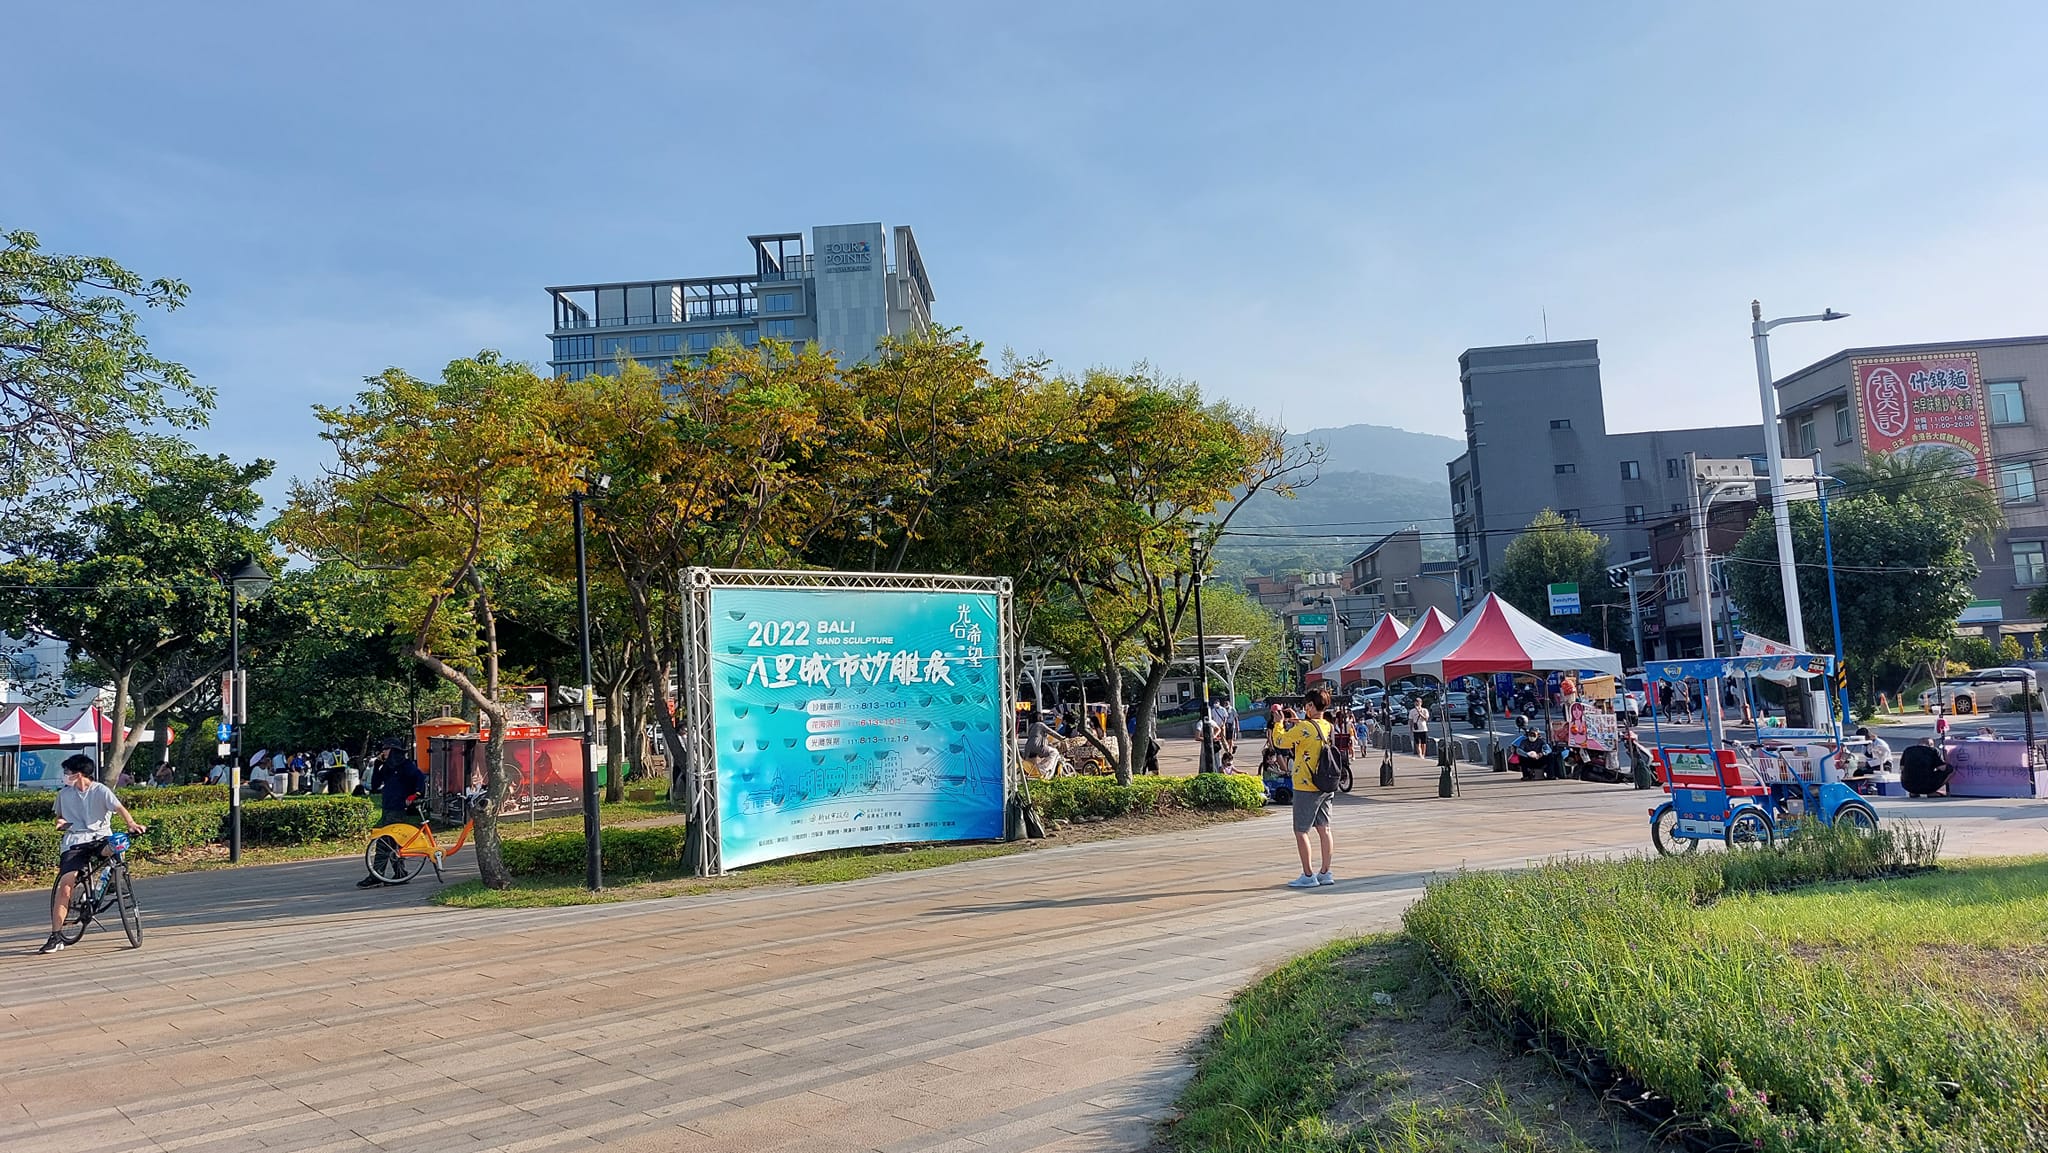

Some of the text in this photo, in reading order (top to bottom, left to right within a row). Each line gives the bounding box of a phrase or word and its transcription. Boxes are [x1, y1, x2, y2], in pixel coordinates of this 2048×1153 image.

[825, 242, 858, 254] FOUR
[825, 253, 871, 265] POINTS
[1909, 369, 1970, 393] 什錦麵
[747, 620, 855, 647] 2022 BALI
[816, 637, 893, 645] SAND SCULPTURE
[747, 651, 955, 688] 八里城市沙雕展
